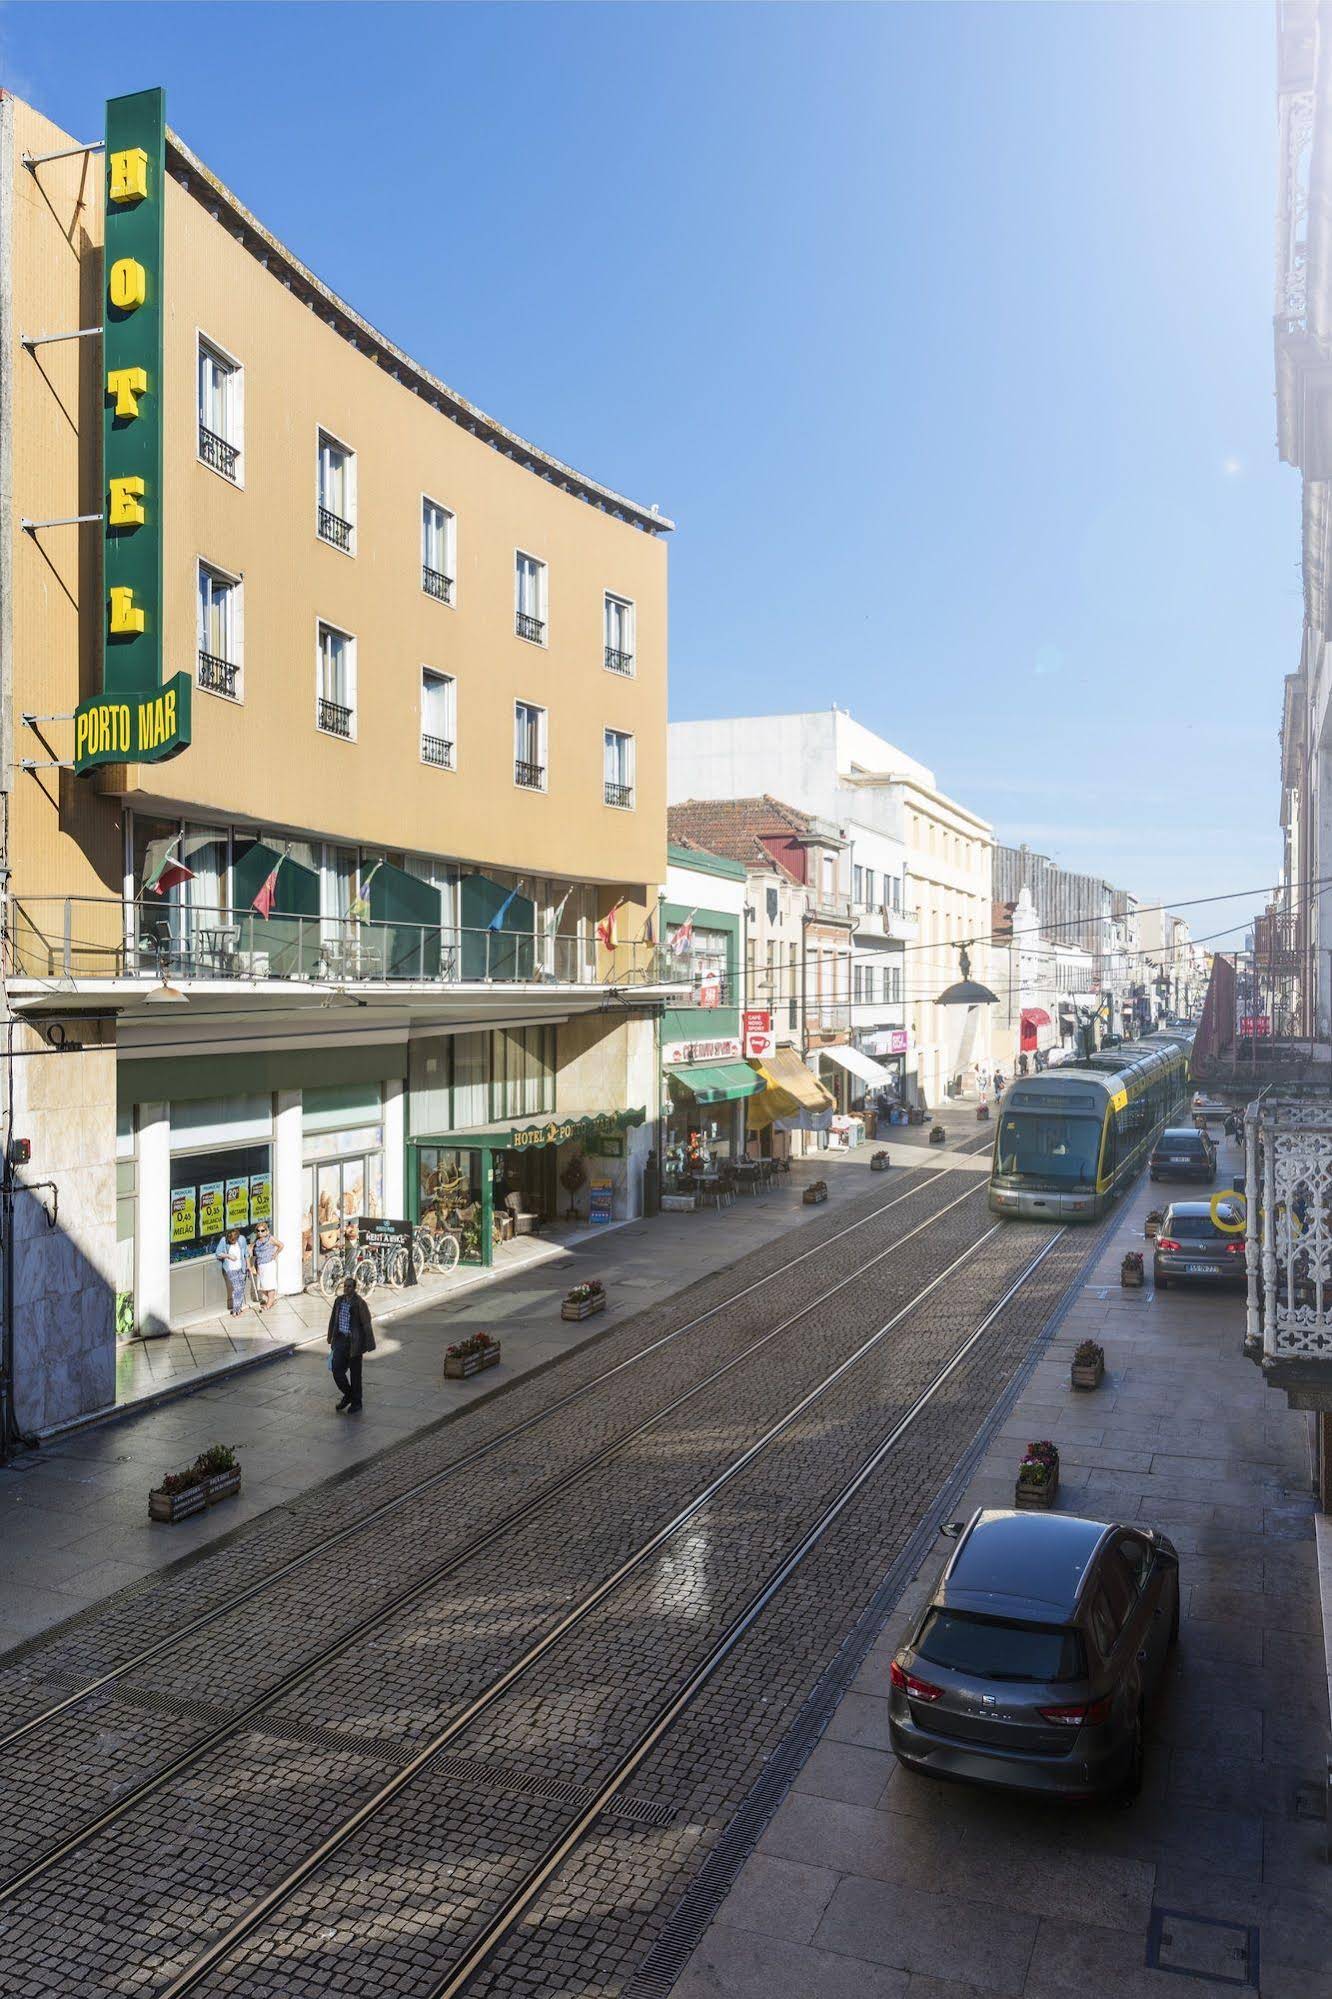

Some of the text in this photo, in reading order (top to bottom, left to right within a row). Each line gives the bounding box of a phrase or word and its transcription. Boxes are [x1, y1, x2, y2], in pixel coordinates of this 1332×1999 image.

[110, 147, 148, 634] HOTEL
[78, 689, 176, 762] PORTO MAR
[514, 1130, 545, 1146] HOTEL
[174, 1225, 193, 1236] MELÃO
[383, 1234, 389, 1242] A
